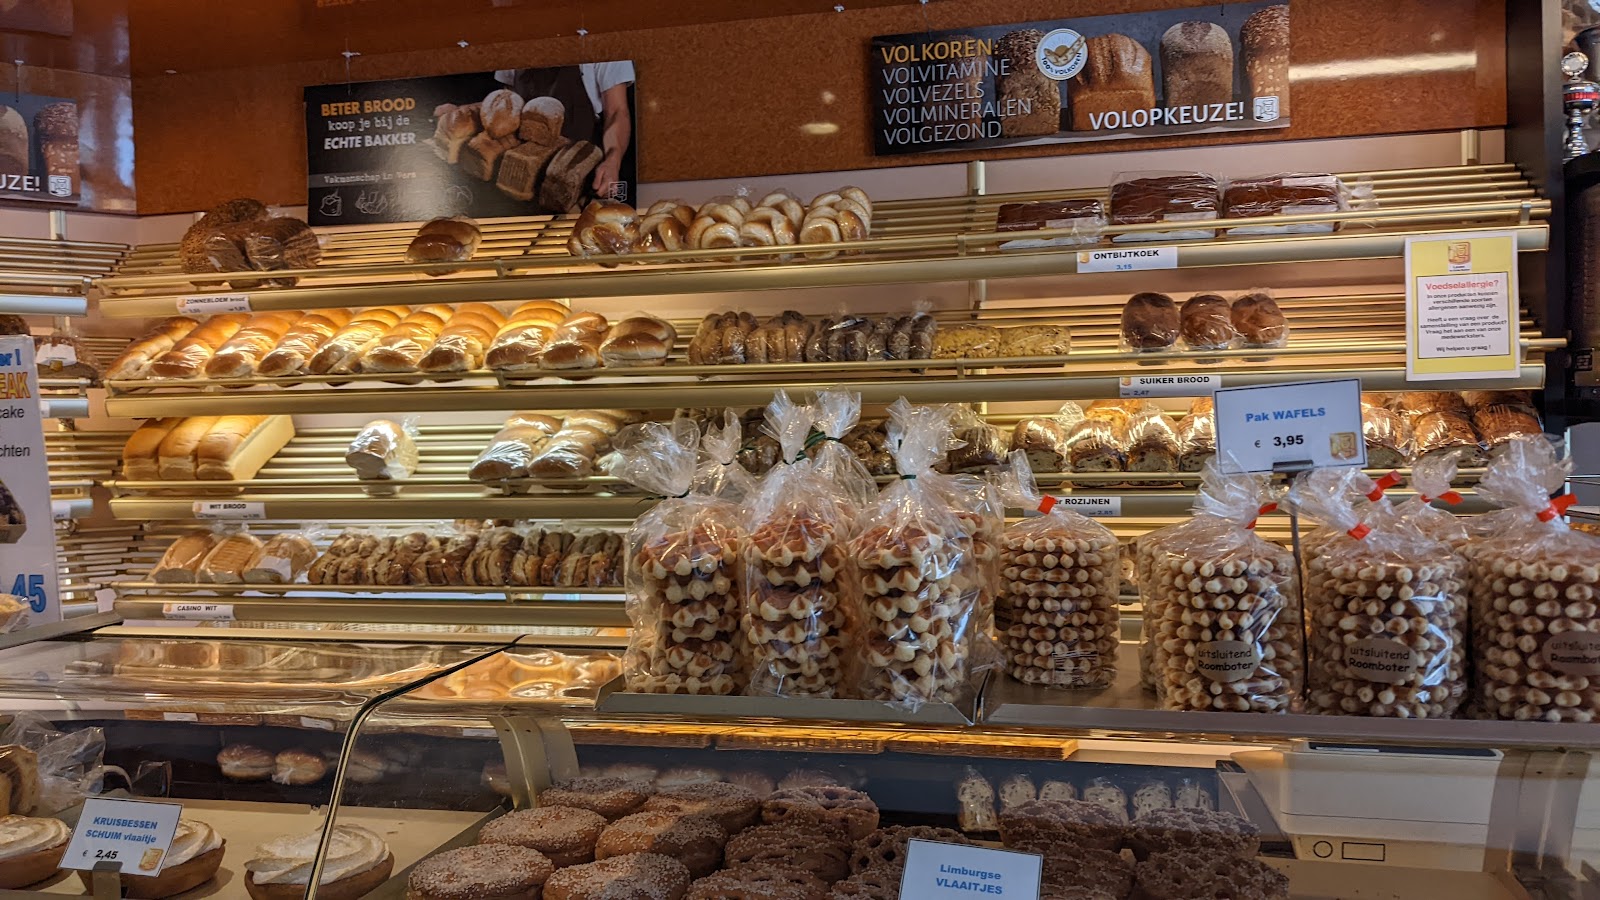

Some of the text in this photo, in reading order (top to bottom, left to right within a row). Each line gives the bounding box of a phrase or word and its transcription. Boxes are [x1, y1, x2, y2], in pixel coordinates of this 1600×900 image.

[881, 38, 999, 64] VOLKOREN:
[882, 58, 1011, 85] VOLVITAMINE
[883, 81, 985, 105] VOLVEZELS
[321, 97, 416, 116] BETER BROOD
[883, 98, 1031, 125] VOLMINERALEN
[1089, 101, 1244, 130] VOLOPKEUZE!
[328, 115, 410, 132] koop je bij de
[884, 121, 1002, 145] VOLGEZOND
[324, 133, 416, 150] ECHTE BAKKER
[1094, 250, 1159, 259] ONTBIJTKOEK
[1425, 280, 1499, 290] Voedselallergie?
[1245, 408, 1326, 422] Pak WAFELS
[1254, 435, 1304, 448] € 3,95
[1199, 647, 1252, 659] uitsluitend
[1350, 647, 1409, 660] uitsluitend
[1198, 661, 1253, 671] Roomboter
[1349, 658, 1410, 672] Roomboter
[93, 816, 159, 829] KRUISBESSEN
[85, 829, 156, 844] SCHUIM vlaaitje
[95, 849, 119, 860] 2,45
[940, 864, 1002, 880] Limburgse
[936, 878, 1003, 895] VLAAITJES
